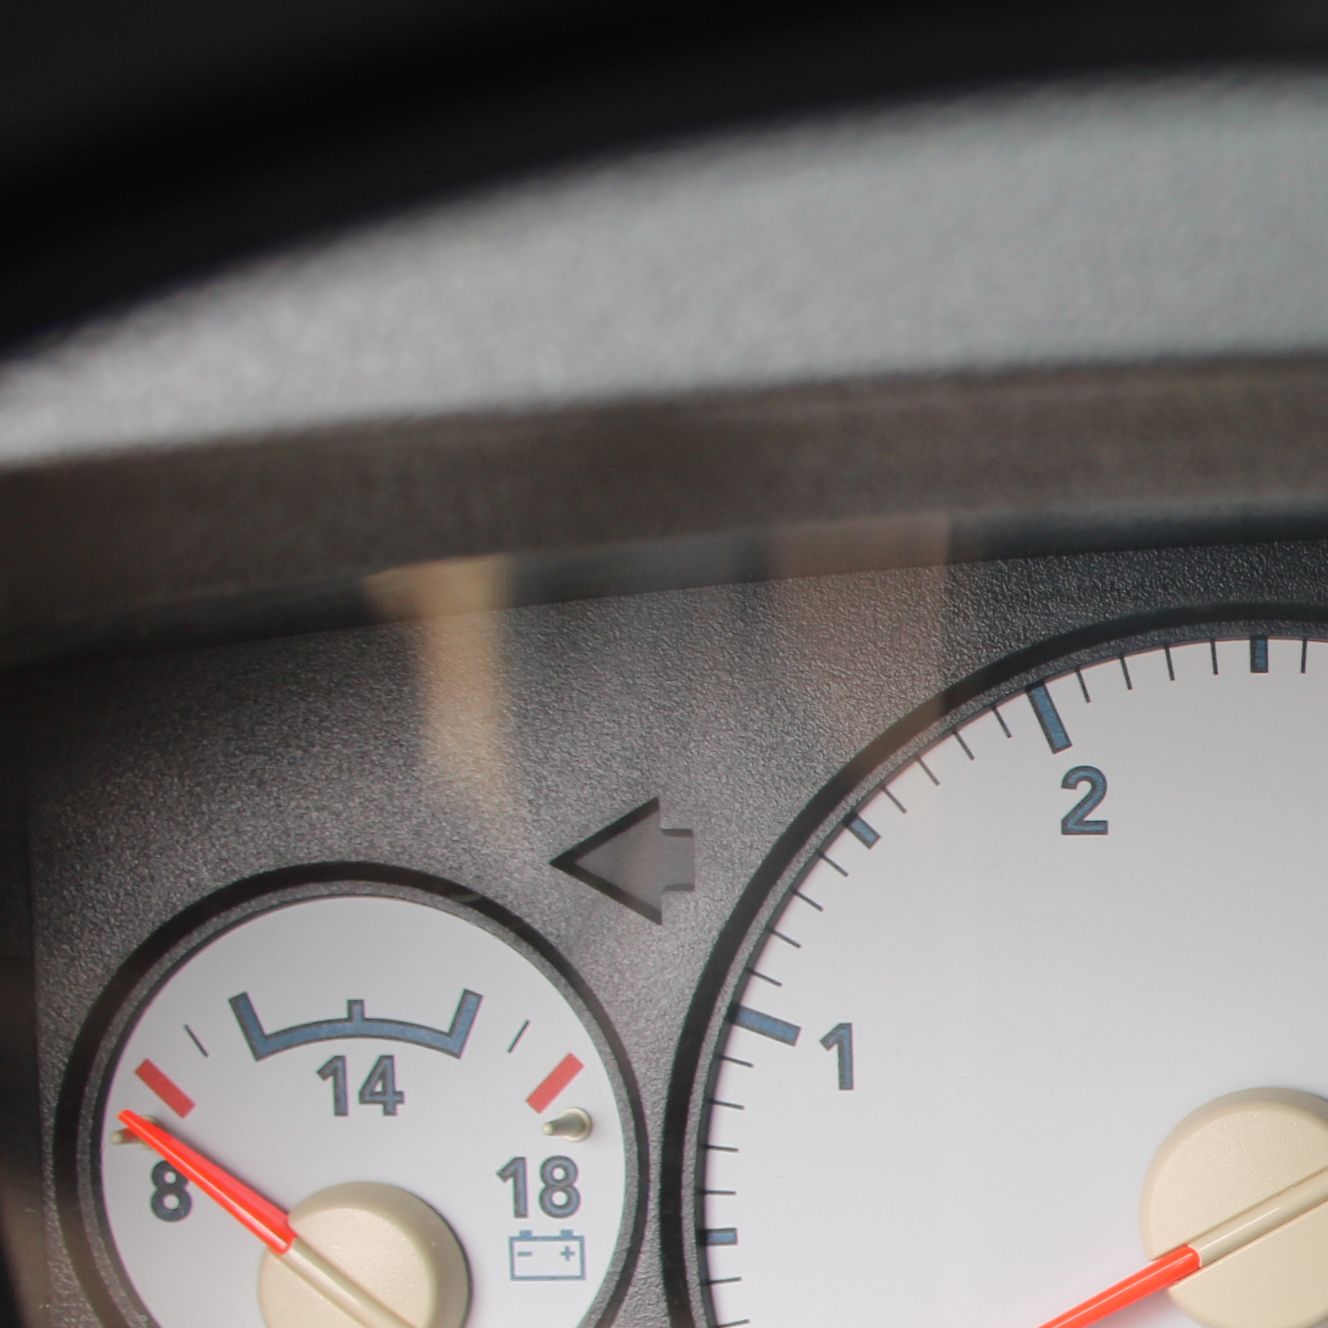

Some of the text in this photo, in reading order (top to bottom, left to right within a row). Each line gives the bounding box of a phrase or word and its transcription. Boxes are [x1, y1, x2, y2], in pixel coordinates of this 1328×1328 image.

[1060, 765, 1109, 835] 2
[316, 1054, 405, 1117] 14
[819, 1022, 854, 1090] 1
[149, 1160, 194, 1222] 8
[495, 1155, 582, 1219] 18
